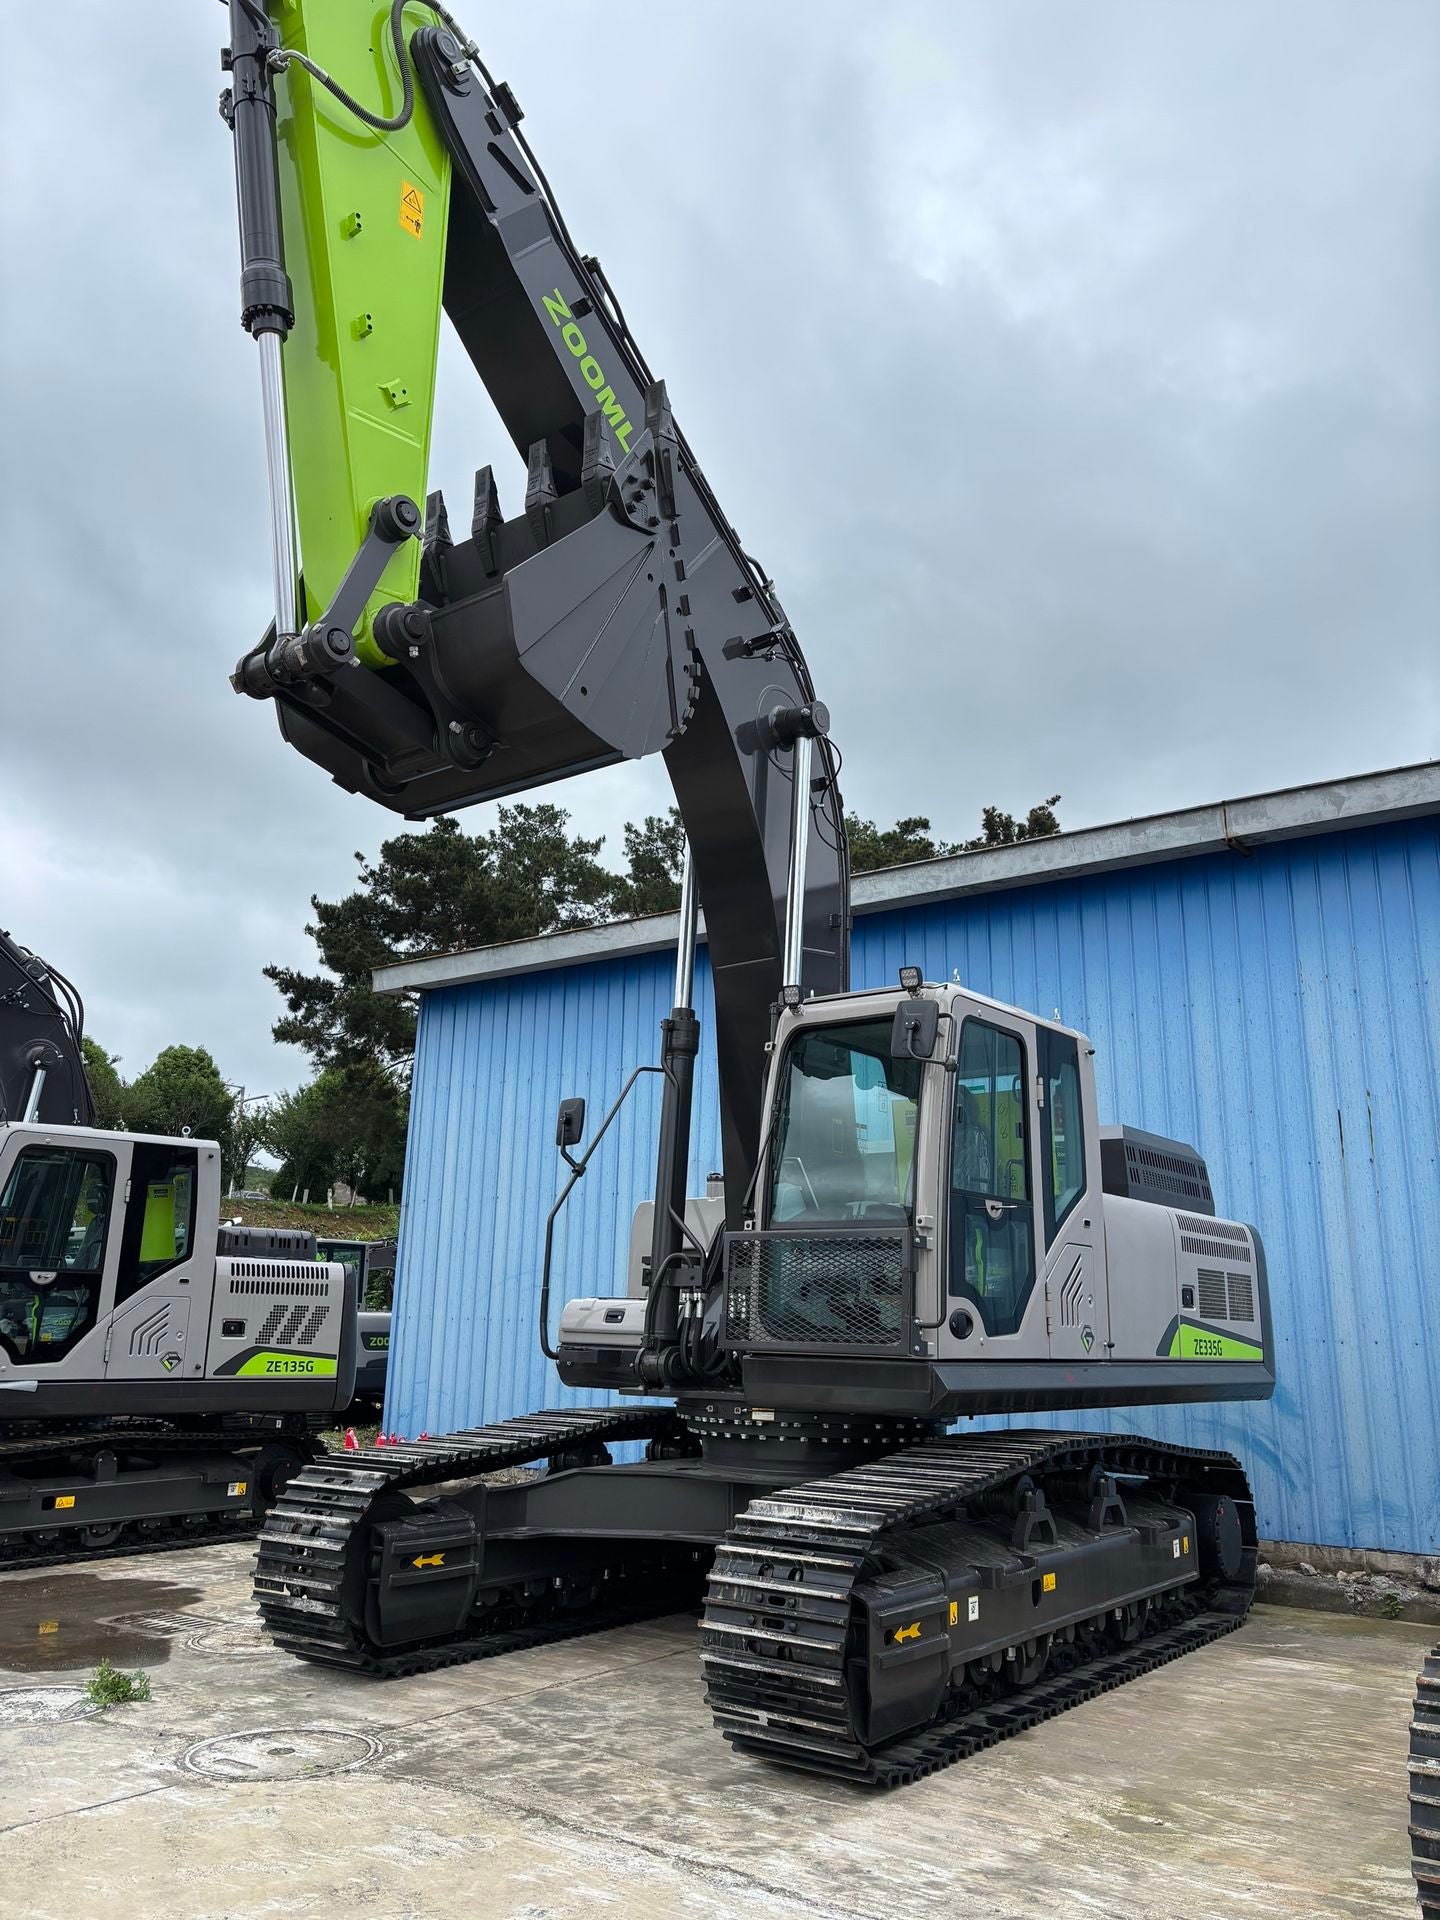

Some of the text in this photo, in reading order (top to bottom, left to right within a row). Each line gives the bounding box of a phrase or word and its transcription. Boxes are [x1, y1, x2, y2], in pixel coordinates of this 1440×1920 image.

[542, 288, 633, 453] ZOOML
[1194, 1339, 1223, 1356] ZE335G
[266, 1360, 314, 1373] ZE135G
